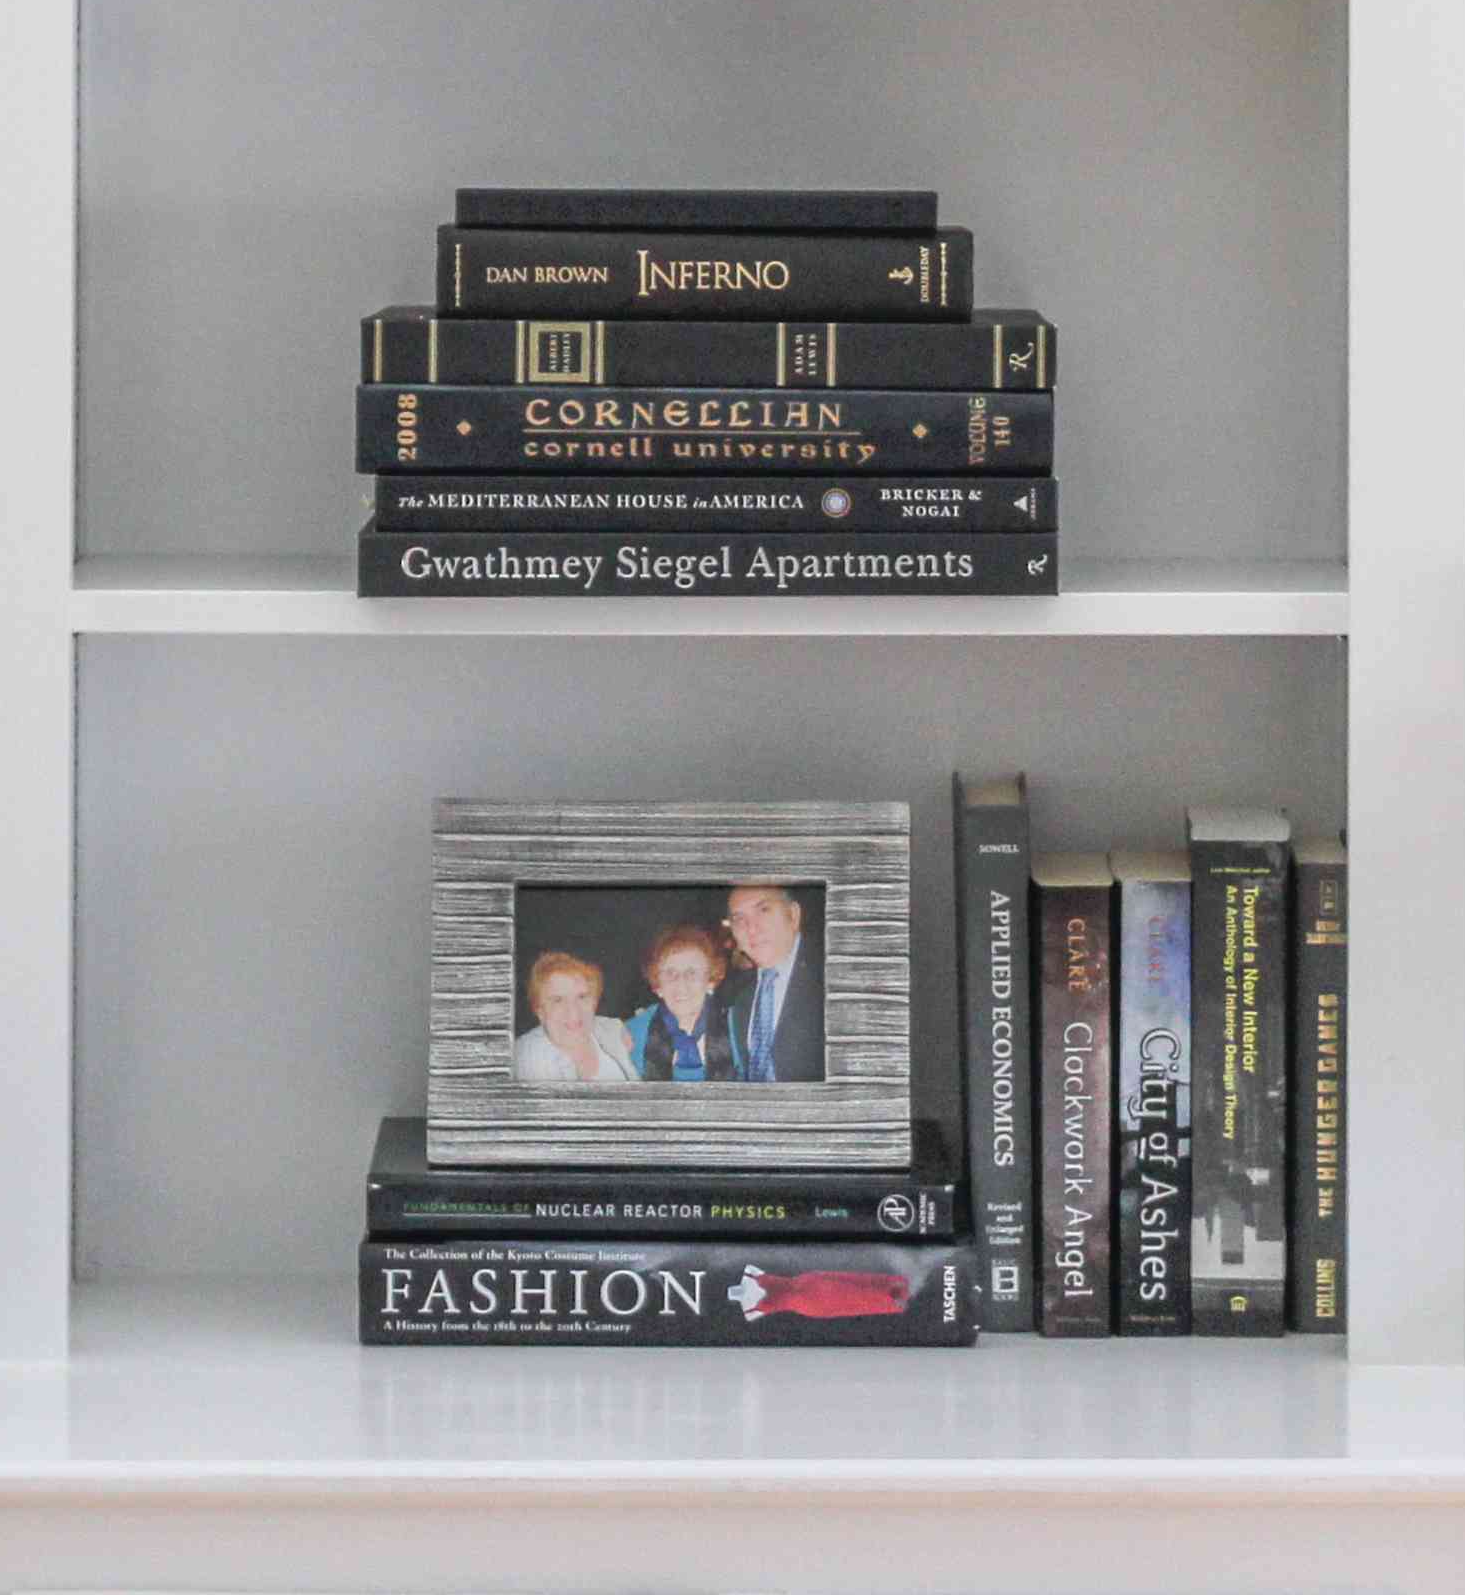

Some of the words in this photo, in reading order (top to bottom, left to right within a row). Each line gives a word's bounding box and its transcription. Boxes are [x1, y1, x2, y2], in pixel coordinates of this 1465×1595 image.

[486, 267, 527, 283] DAN
[534, 267, 609, 284] BROWN
[637, 249, 789, 296] INFERNO
[397, 394, 417, 461] 2008
[525, 398, 842, 429] CORNELLIAN
[524, 437, 653, 458] cornell
[674, 438, 876, 465] university
[398, 496, 423, 508] The
[428, 493, 610, 509] MEDITERRANEAN
[616, 493, 687, 509] HOUSE
[709, 493, 804, 509] AMERICA
[881, 489, 962, 501] BRICKER
[902, 505, 960, 517] NOGAI
[401, 546, 602, 589] Gwathmey
[616, 546, 732, 589] Siegel
[746, 546, 973, 589] Apartments
[1227, 885, 1237, 902] An
[1224, 906, 1237, 977] Anthology
[1242, 885, 1258, 953] Toward
[991, 890, 1011, 999] APPLIED
[1066, 918, 1086, 992] CLARE
[1244, 957, 1254, 965] a
[1227, 979, 1237, 992] of
[1242, 967, 1258, 1006] New
[1226, 993, 1237, 1041] Interior
[1318, 994, 1338, 1073] GAMES
[1241, 1010, 1257, 1073] Interior
[992, 1006, 1015, 1167] ECONOMICS
[1126, 1028, 1180, 1120] City
[1224, 1043, 1236, 1089] Design
[1062, 1021, 1092, 1195] Clockwork
[1223, 1091, 1235, 1140] Theory
[1316, 1080, 1337, 1181] HUNGER
[1134, 1130, 1179, 1169] of
[536, 1204, 615, 1218] NUCLEAR
[624, 1204, 702, 1219] REACTOR
[711, 1205, 785, 1219] PHYSICS
[1318, 1187, 1332, 1217] THE
[1055, 1205, 1092, 1297] Angel
[1140, 1176, 1179, 1301] Ashes
[381, 1268, 706, 1315] FASHION
[943, 1265, 956, 1324] TASCHEN
[1316, 1259, 1334, 1317] COLLINS
